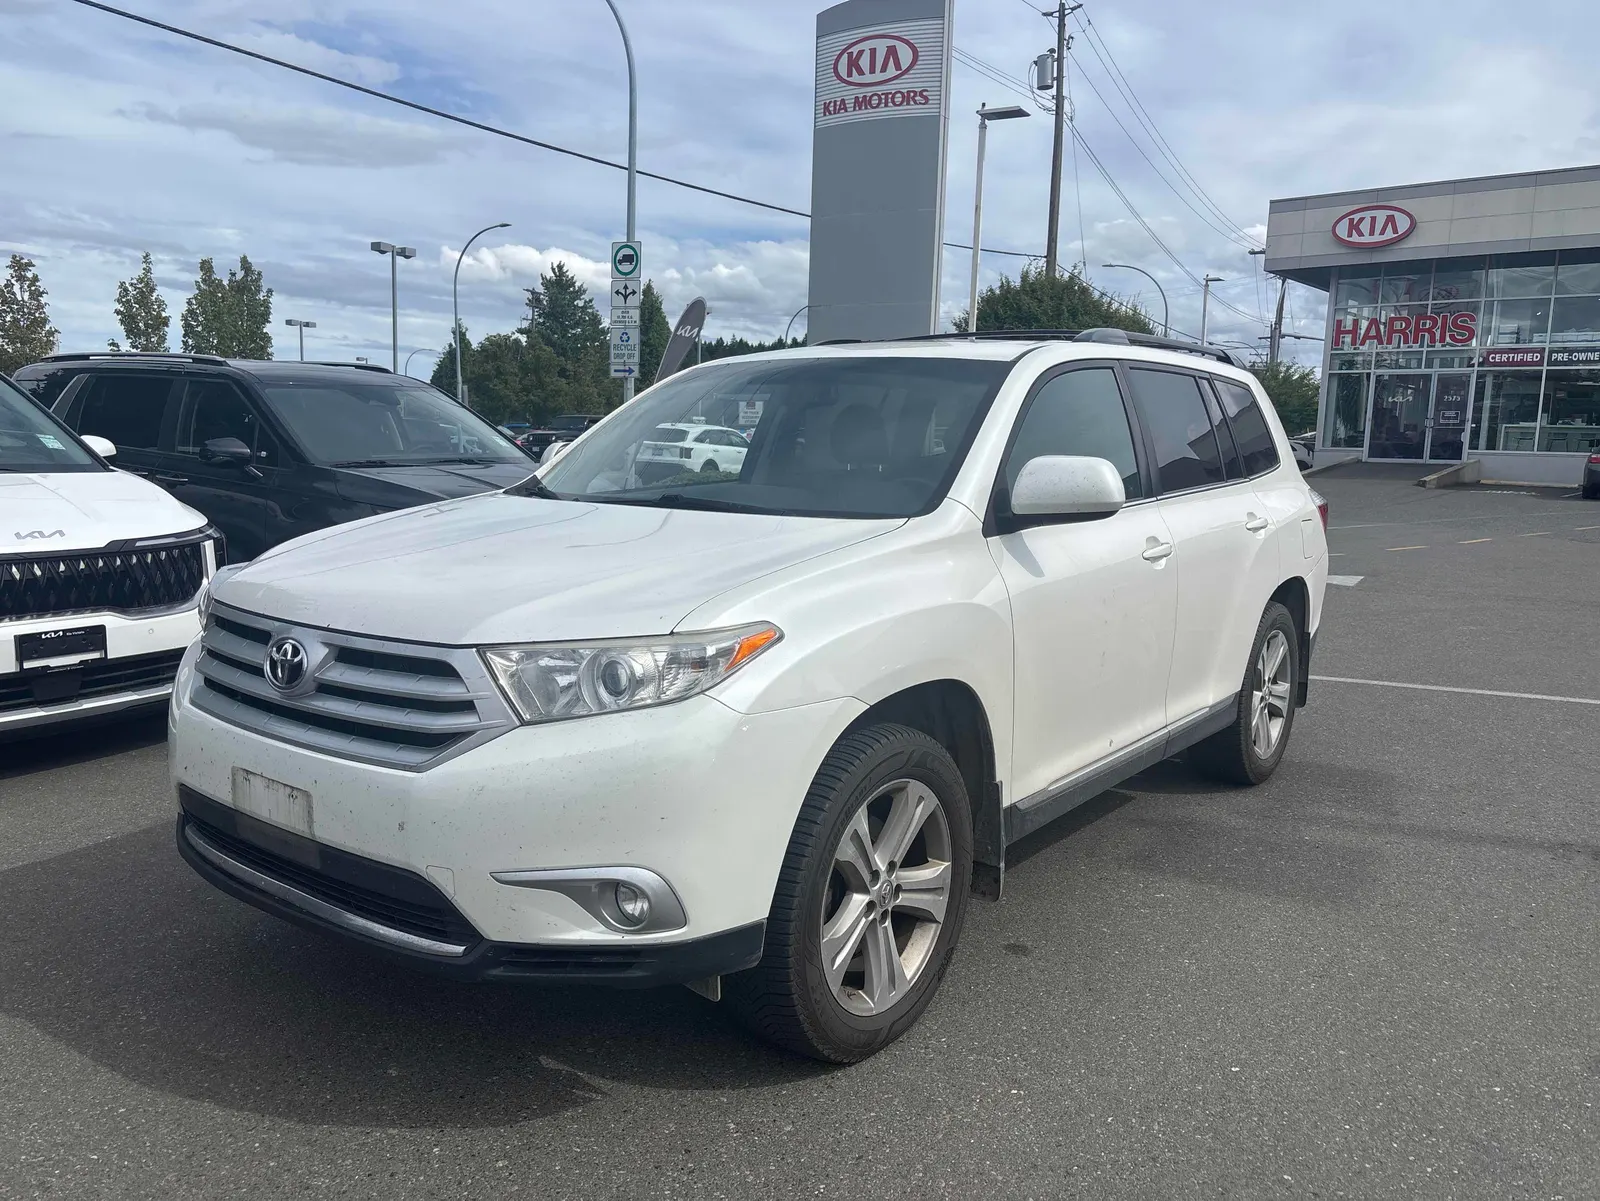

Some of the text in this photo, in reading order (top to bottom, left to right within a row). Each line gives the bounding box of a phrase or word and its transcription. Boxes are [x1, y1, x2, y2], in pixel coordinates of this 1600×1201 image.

[846, 44, 902, 78] KIA
[823, 89, 930, 117] KIA MOTORS
[1347, 214, 1399, 238] KIA
[1333, 312, 1477, 347] HARRIS
[612, 343, 637, 352] RECYCLE
[613, 352, 636, 360] DROP OFF
[1488, 353, 1541, 362] CERTIFIED
